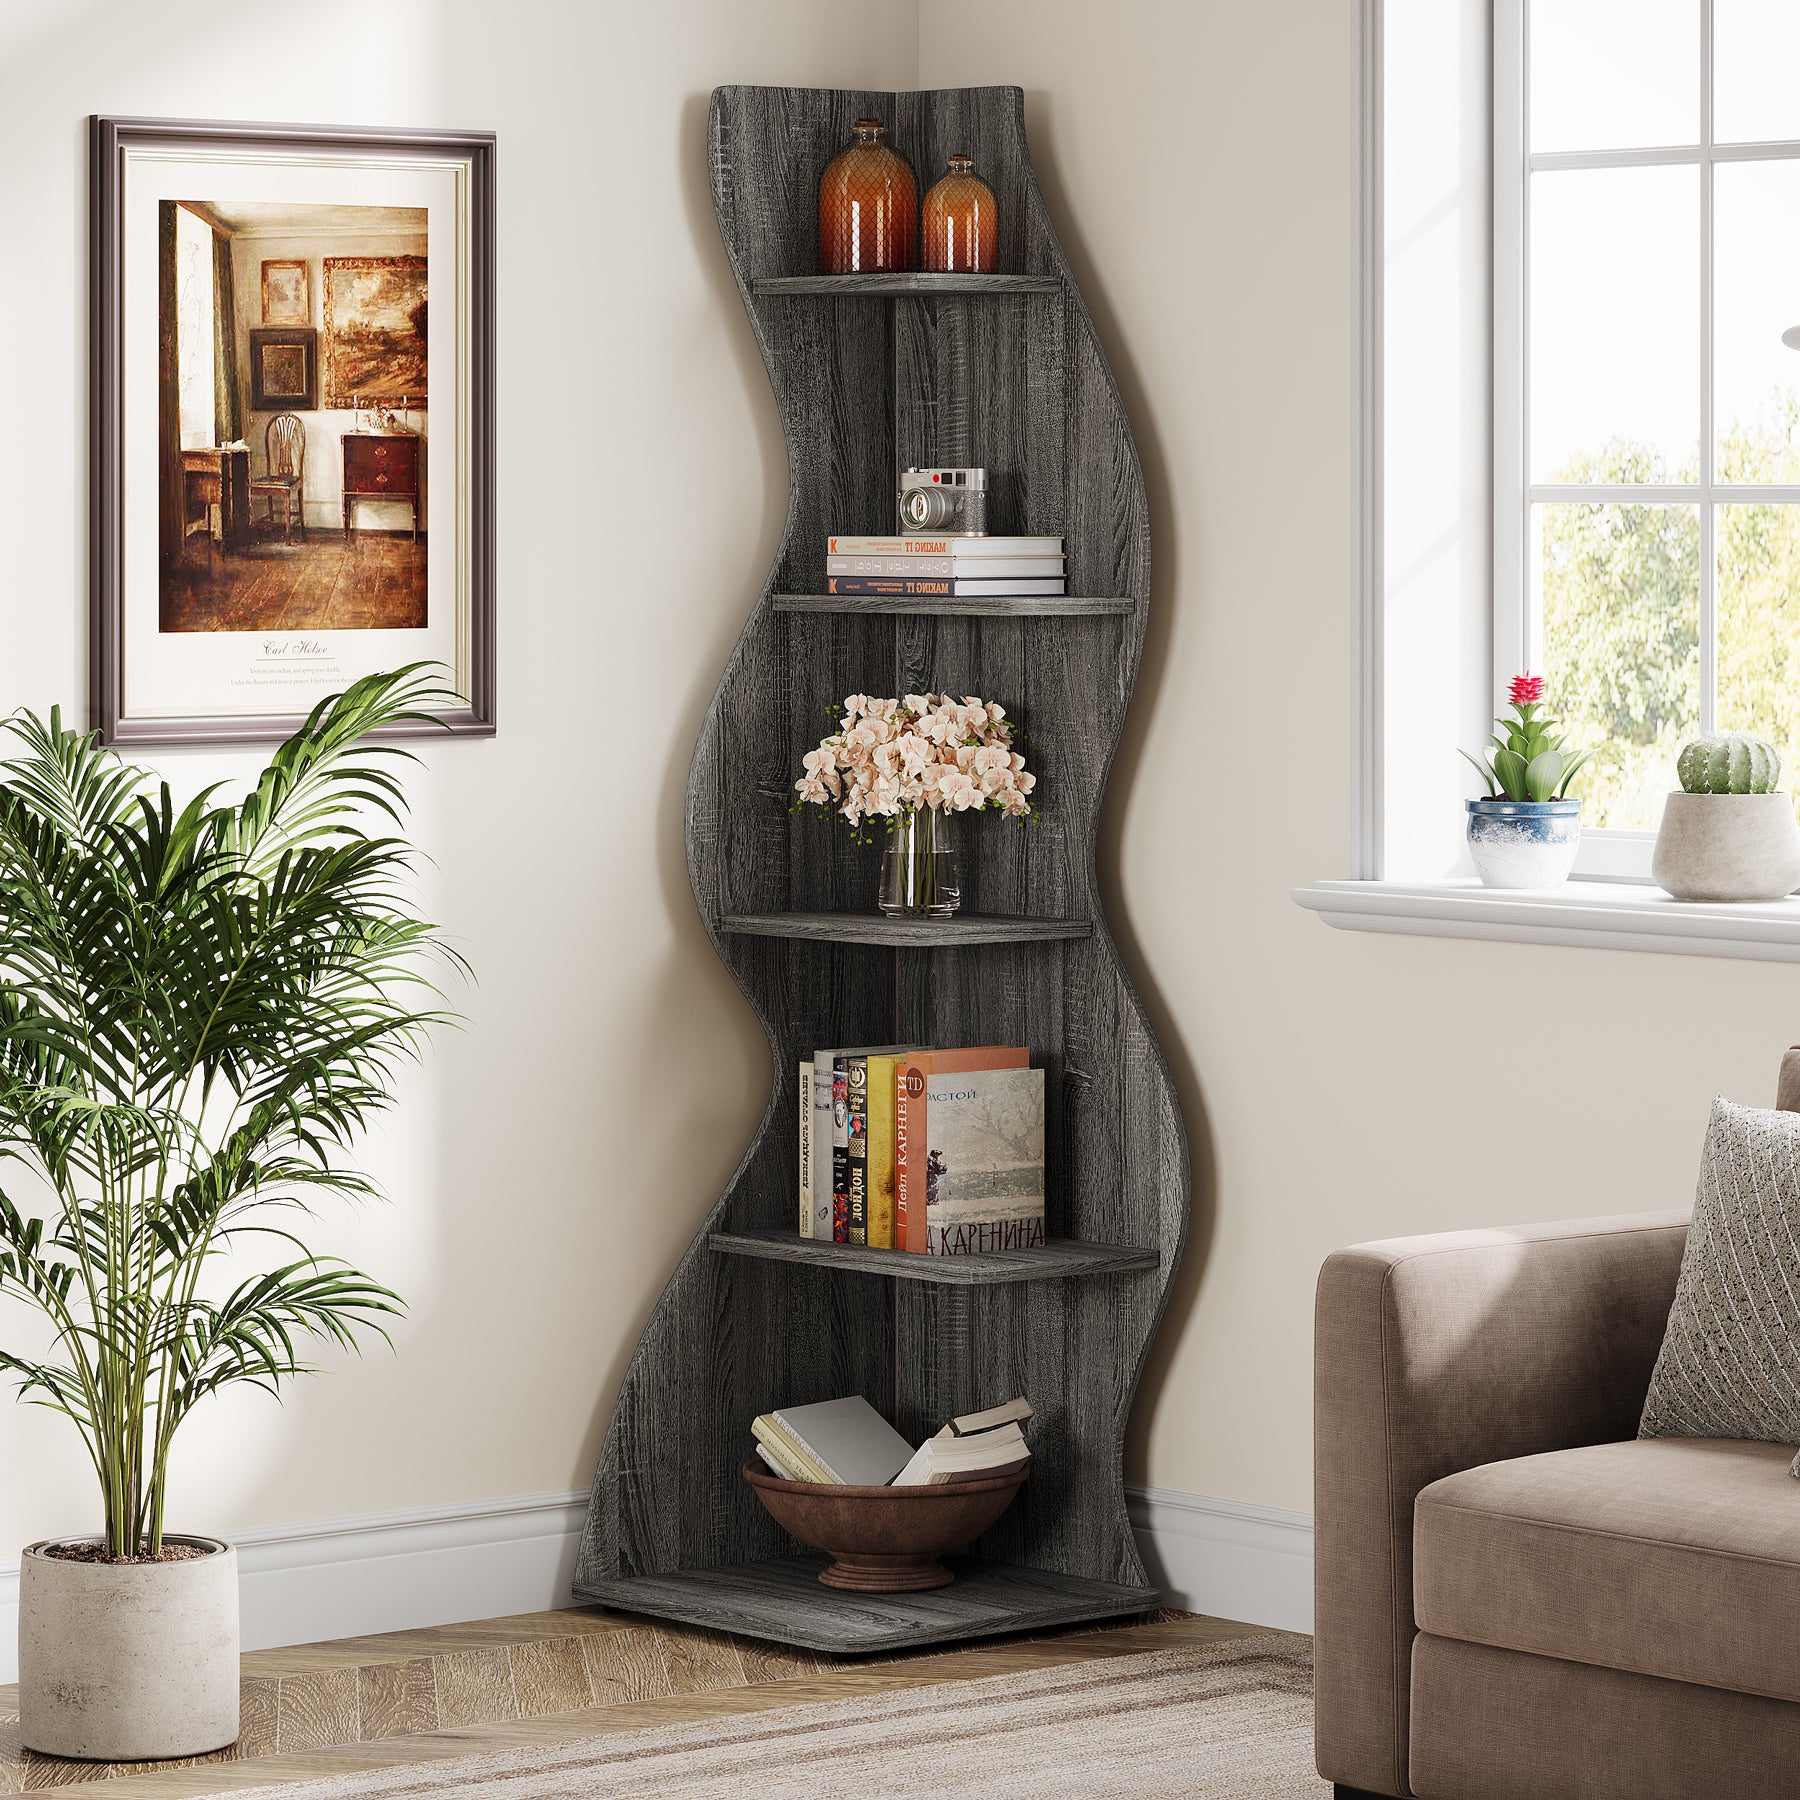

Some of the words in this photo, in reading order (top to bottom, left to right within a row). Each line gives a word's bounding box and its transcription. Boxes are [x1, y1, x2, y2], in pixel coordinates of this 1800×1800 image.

[263, 640, 289, 656] Carl
[897, 1074, 907, 1166] КАРНЕГИ
[852, 1167, 865, 1221] ЛОНДОН
[897, 1174, 907, 1211] Дейл
[940, 1217, 1044, 1256] КАРЕНИНА
